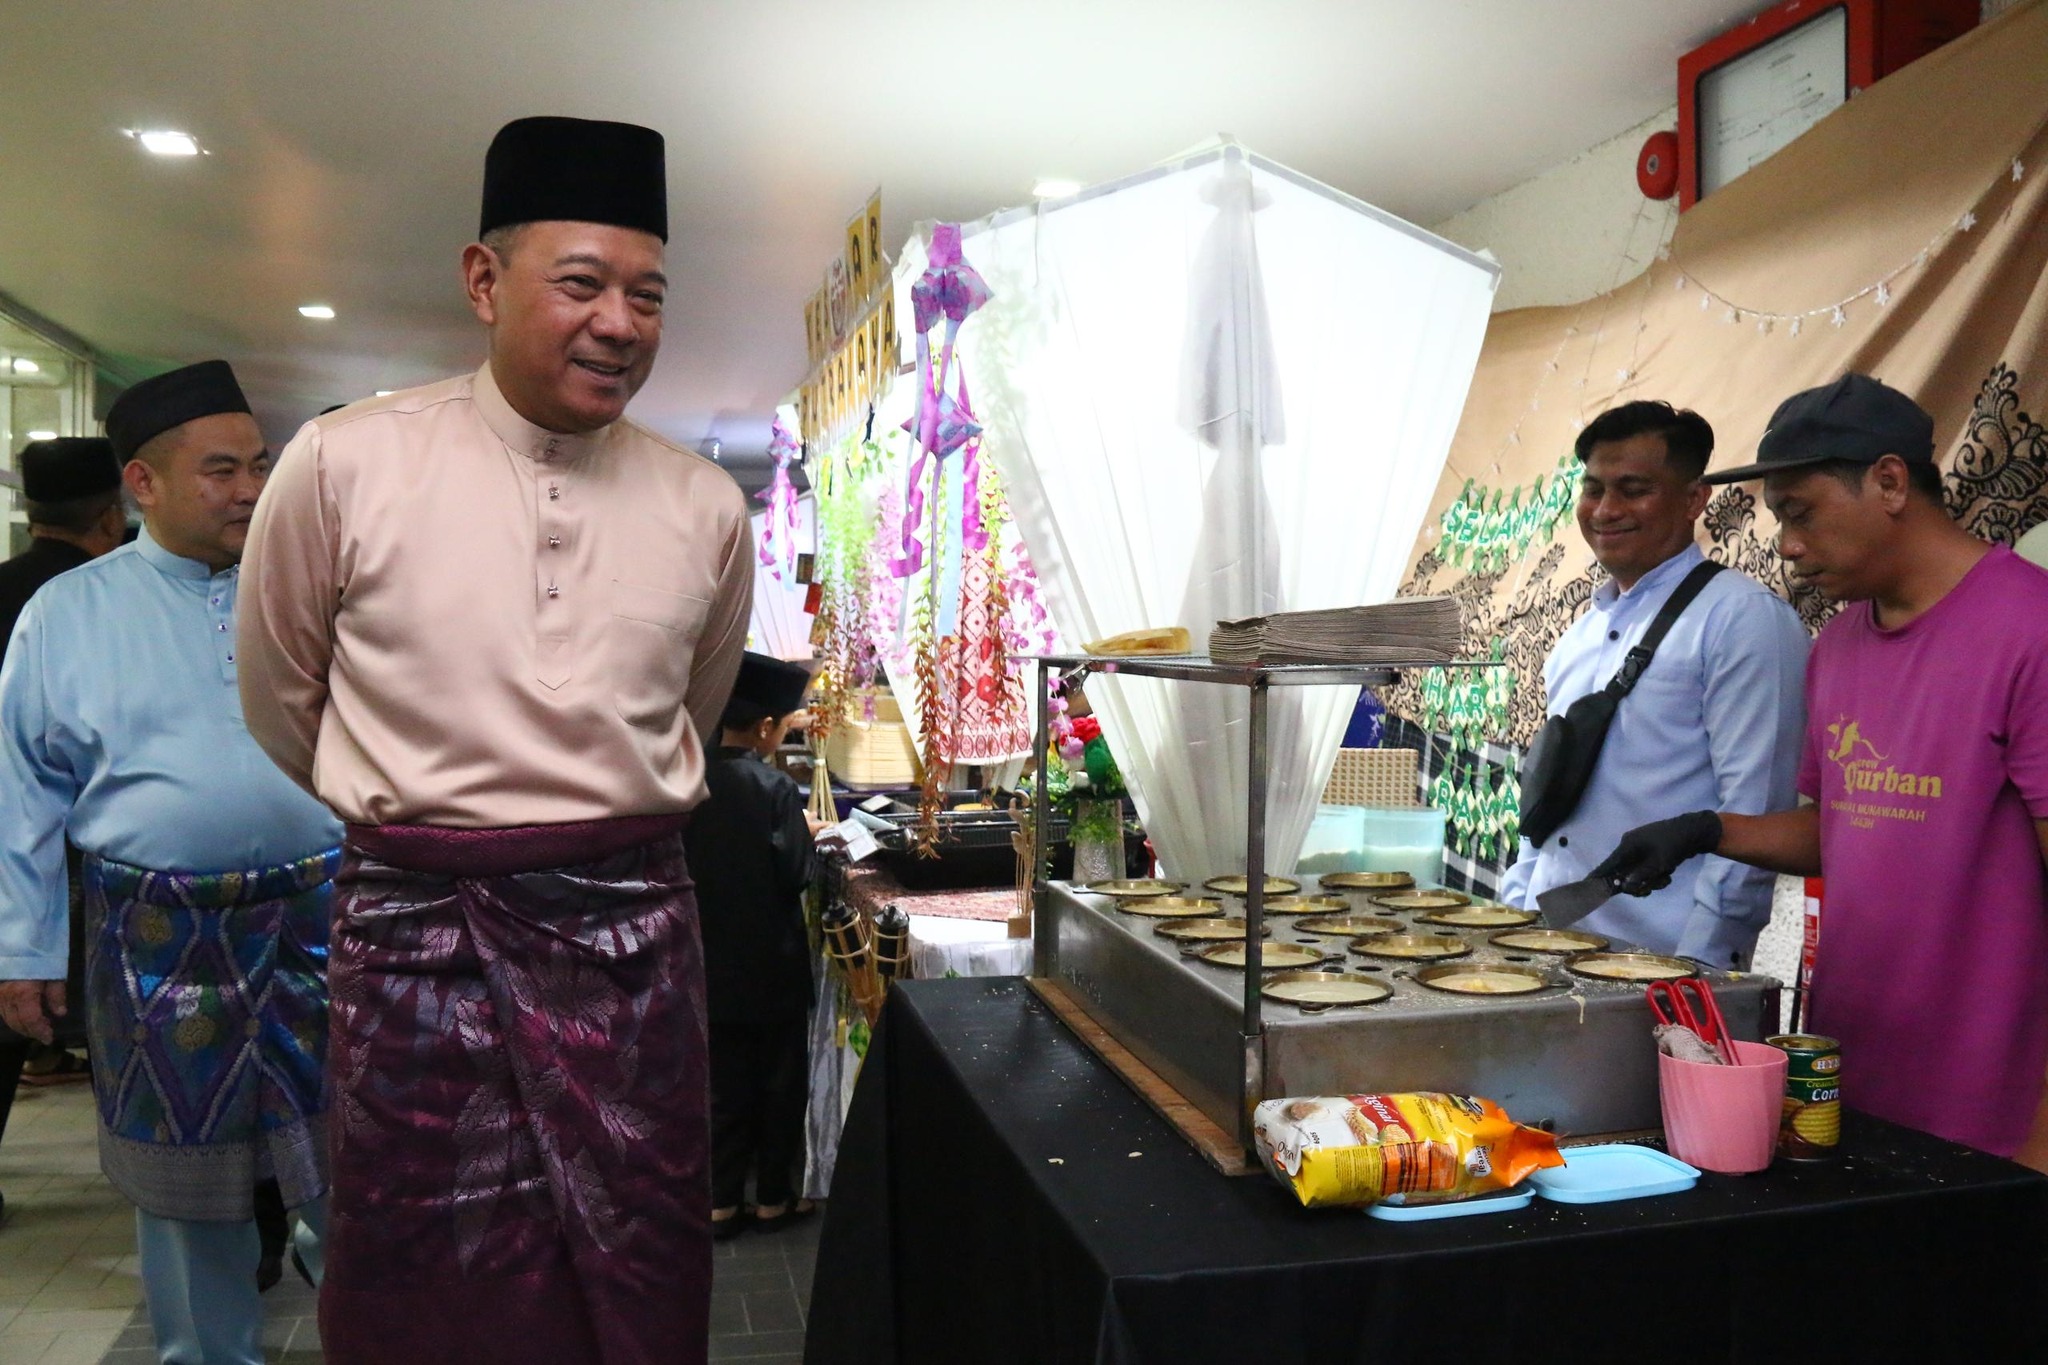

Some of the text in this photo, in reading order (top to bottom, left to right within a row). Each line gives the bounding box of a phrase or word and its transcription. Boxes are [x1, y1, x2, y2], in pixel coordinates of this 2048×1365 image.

[1446, 467, 1583, 544] SELAMAT
[1427, 668, 1501, 720] HARI
[1844, 761, 1942, 798] Qurban
[1437, 778, 1520, 834] RAYA
[1363, 1095, 1400, 1124] iginal
